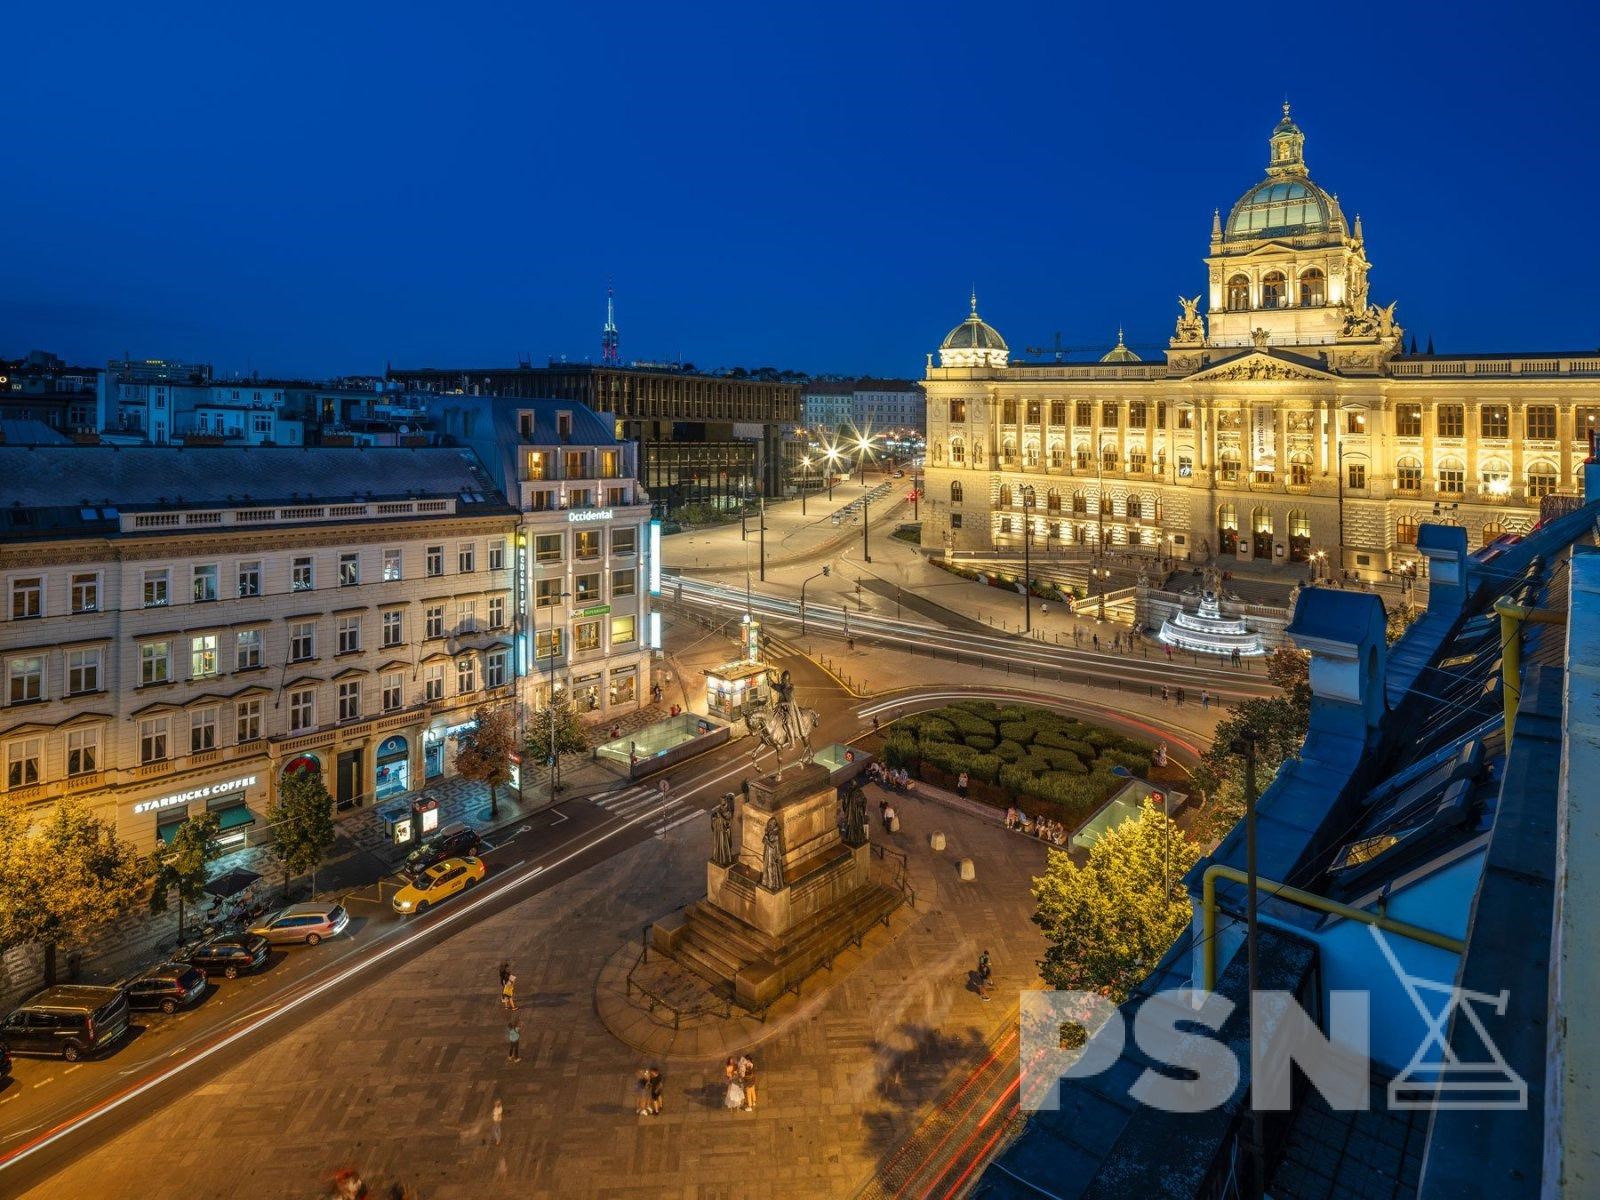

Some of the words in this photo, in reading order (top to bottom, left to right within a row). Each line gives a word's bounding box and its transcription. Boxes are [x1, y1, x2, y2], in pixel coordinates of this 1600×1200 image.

[568, 509, 613, 522] Occidental
[134, 788, 211, 814] STARBUCKS
[212, 776, 257, 794] COFFEE
